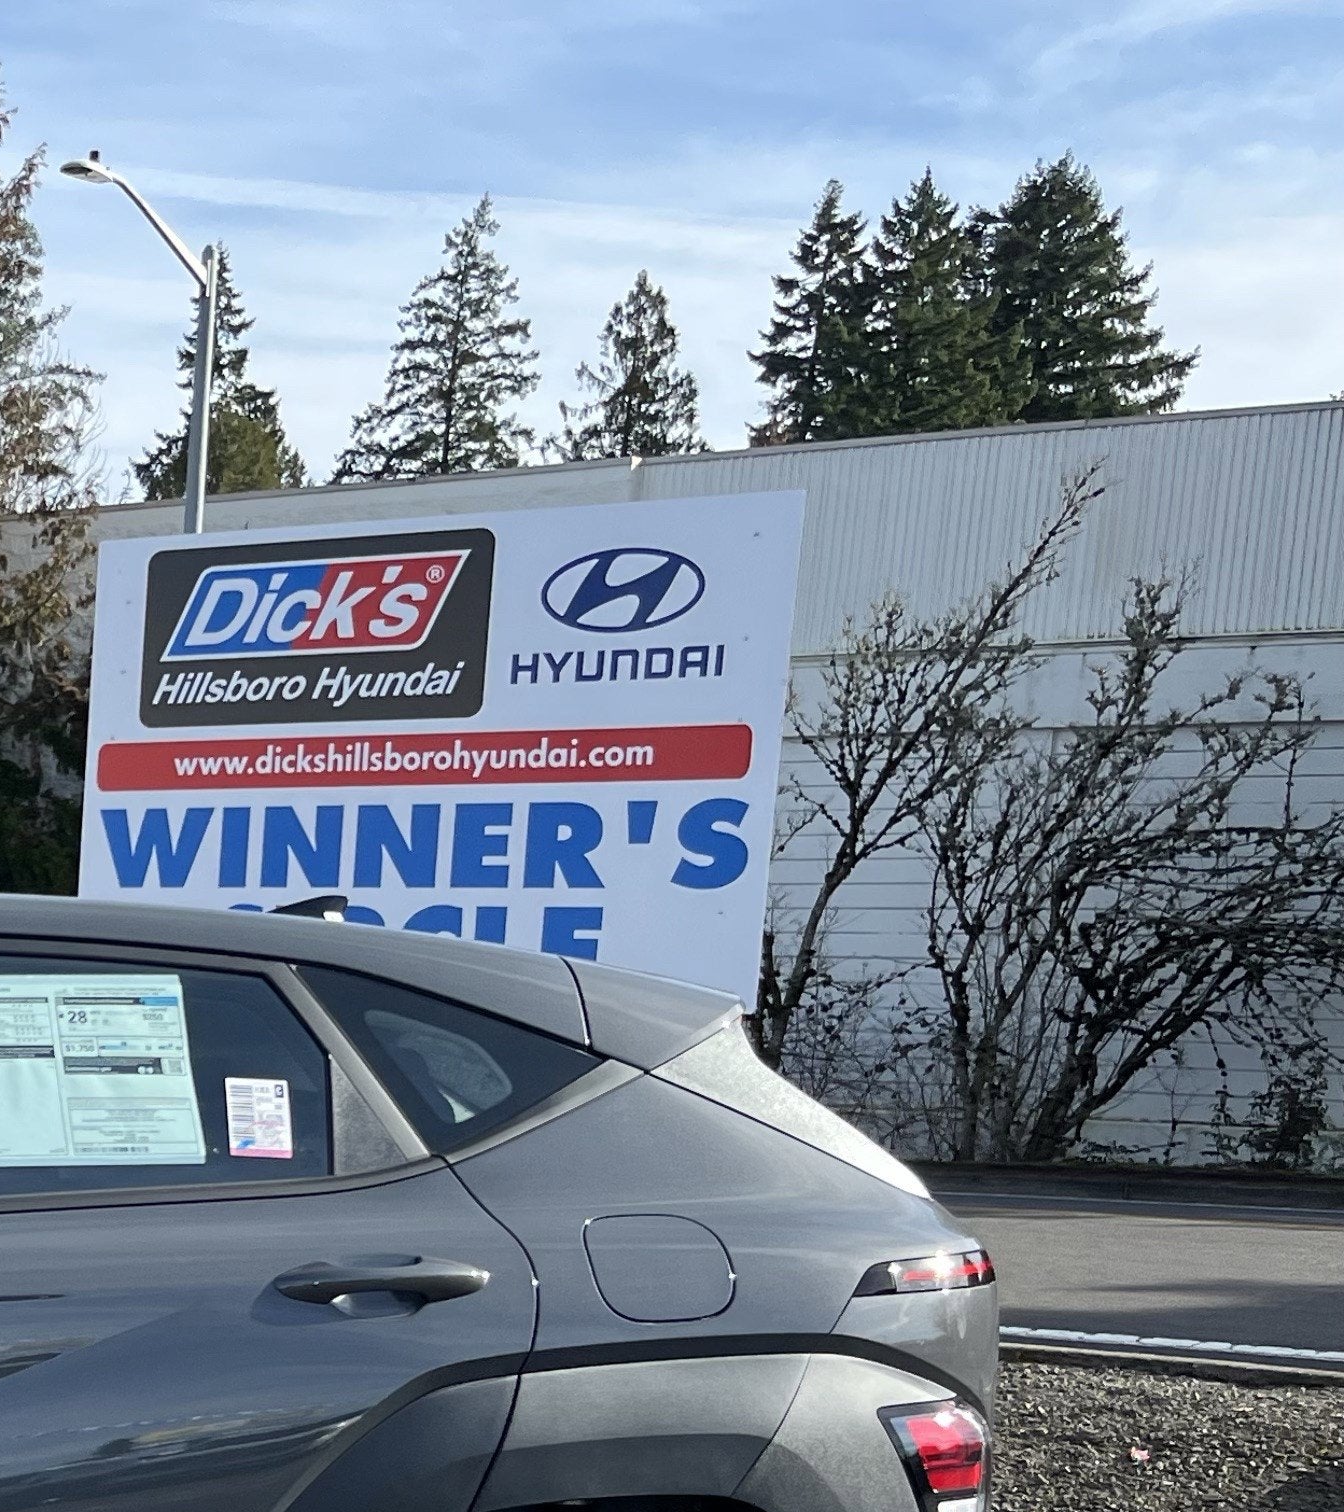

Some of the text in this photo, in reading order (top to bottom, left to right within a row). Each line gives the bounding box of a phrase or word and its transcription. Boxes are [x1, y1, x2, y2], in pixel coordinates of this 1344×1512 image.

[187, 564, 428, 646] Dick's
[152, 660, 466, 708] Hillsboro Hyundai
[510, 644, 726, 685] HYUNDAI
[173, 738, 654, 780] www.dickshillsborohyundai.com
[100, 797, 750, 890] WINNER'S
[67, 1010, 88, 1024] 28
